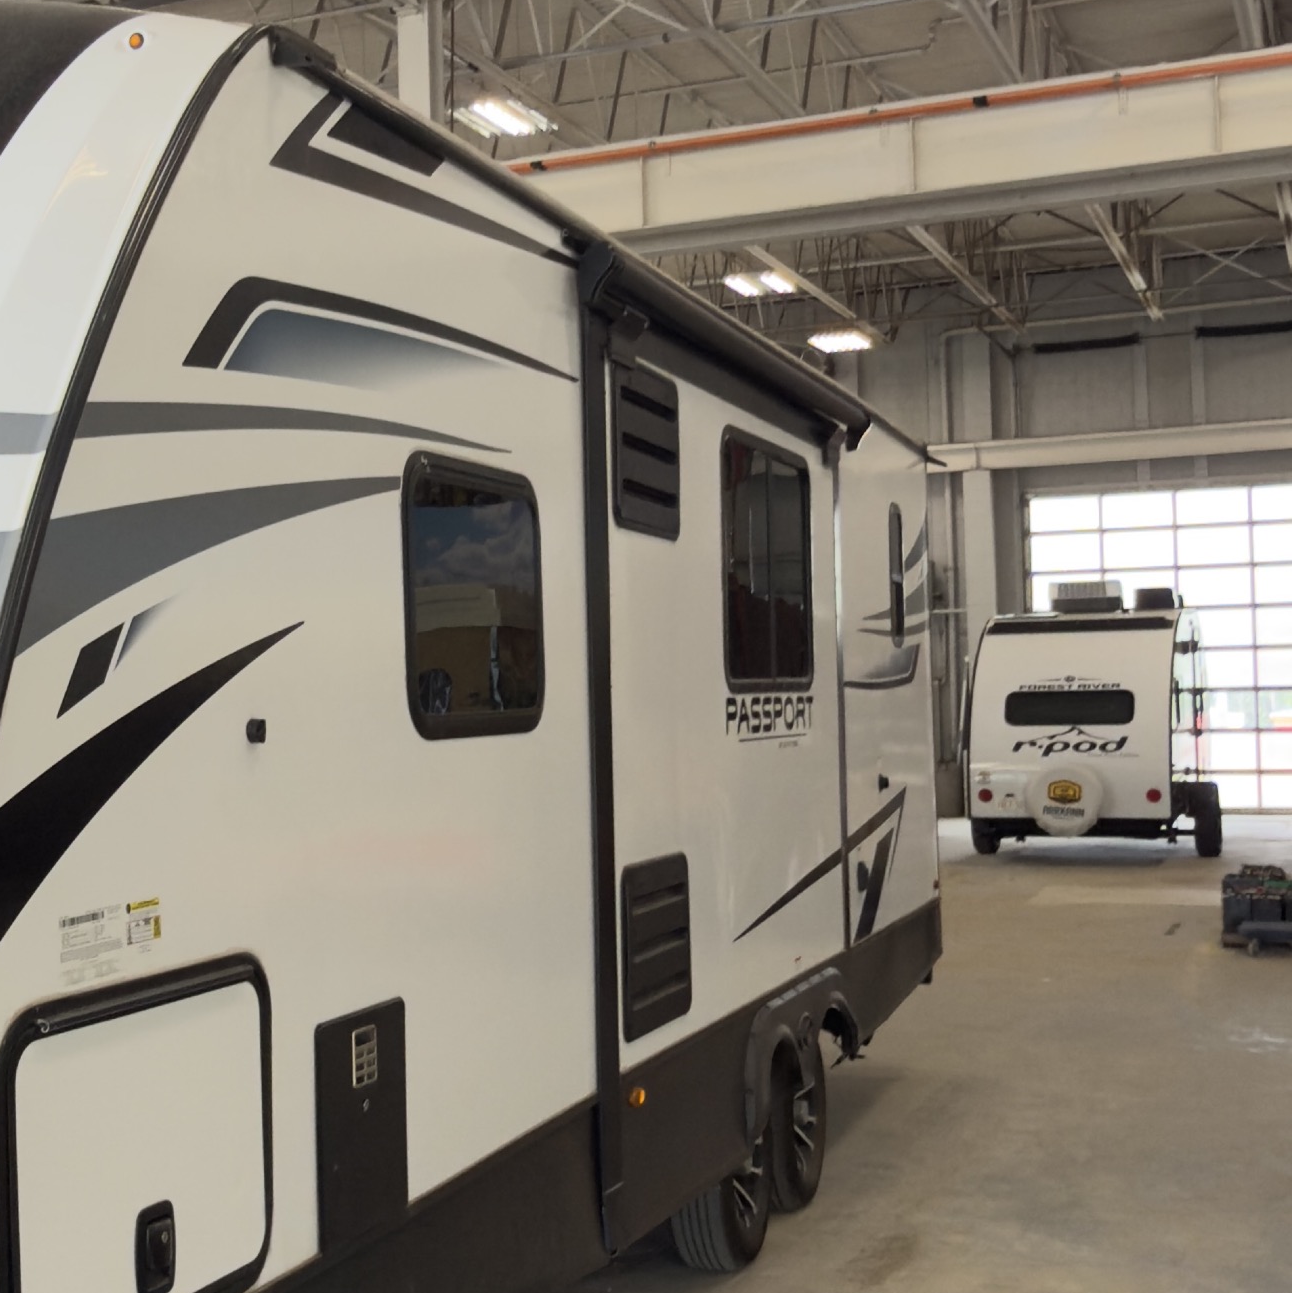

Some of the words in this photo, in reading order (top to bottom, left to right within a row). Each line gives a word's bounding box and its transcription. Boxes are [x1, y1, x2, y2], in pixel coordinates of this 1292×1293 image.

[1018, 683, 1074, 691] FOREST
[1076, 682, 1121, 690] RIVER
[725, 695, 814, 736] PASSPORT
